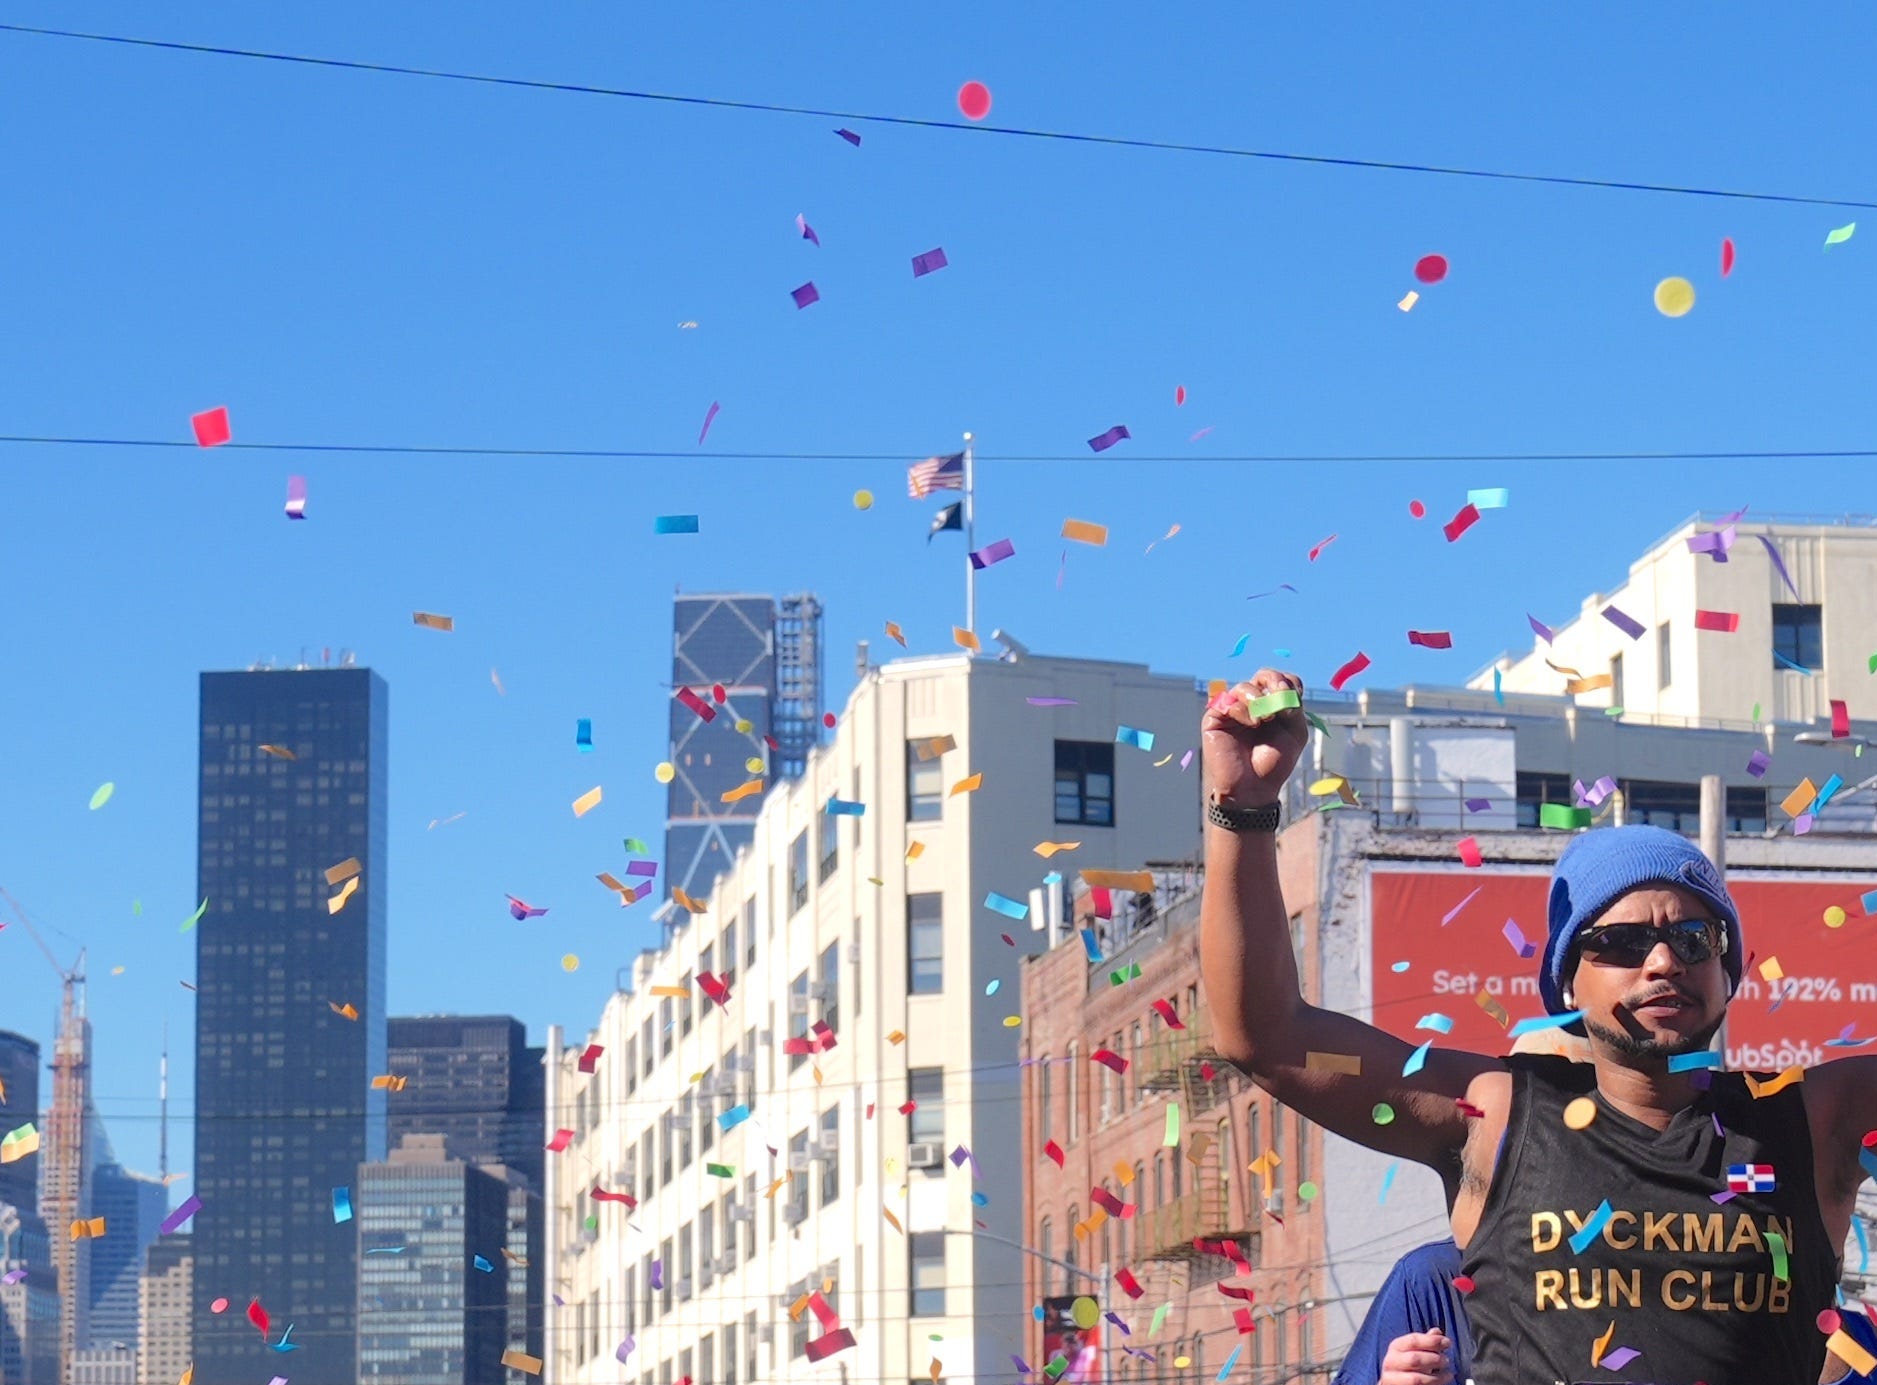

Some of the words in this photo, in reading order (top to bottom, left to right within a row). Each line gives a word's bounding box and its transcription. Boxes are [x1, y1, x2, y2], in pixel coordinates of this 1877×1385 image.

[1433, 969, 1478, 995] Set
[1484, 976, 1503, 995] a
[1769, 977, 1842, 1001] 192%
[1725, 1038, 1823, 1072] ubSpot
[1535, 1267, 1642, 1311] RUN
[1661, 1270, 1793, 1313] CLUB
